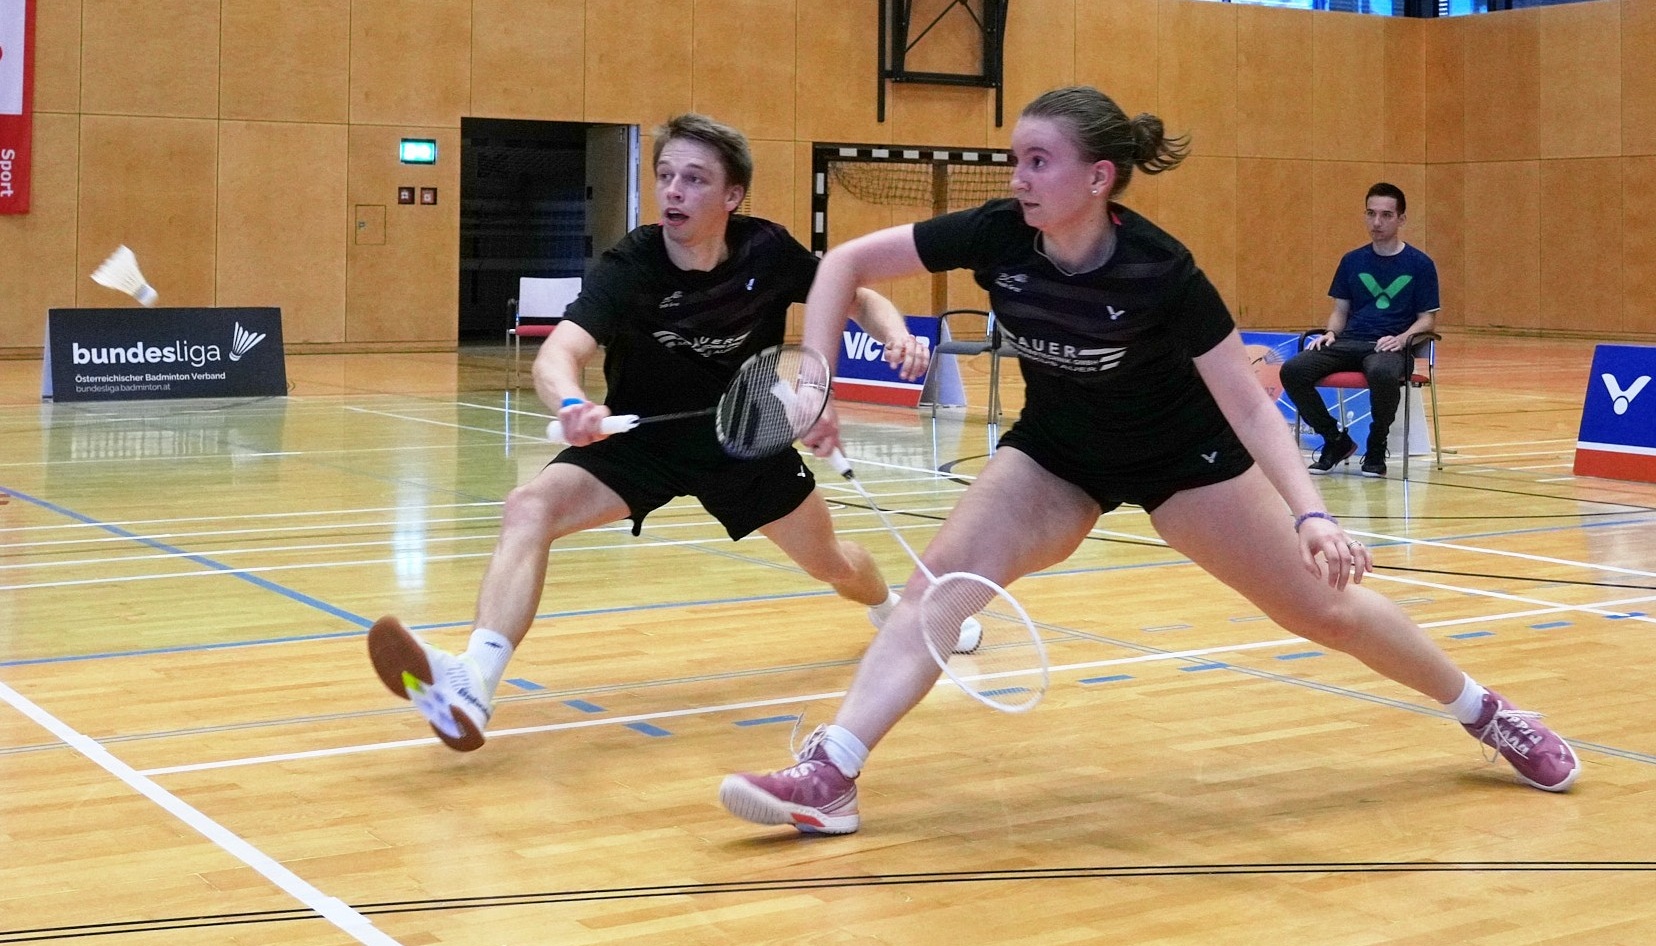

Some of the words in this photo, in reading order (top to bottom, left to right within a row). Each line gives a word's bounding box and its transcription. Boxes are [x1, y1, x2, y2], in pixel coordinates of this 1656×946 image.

[0, 149, 15, 197] Sport
[72, 340, 221, 367] bundesliga
[843, 331, 930, 361] VIC
[75, 374, 143, 383] Österreichischer
[145, 373, 190, 381] Badminton
[191, 372, 225, 380] Verband
